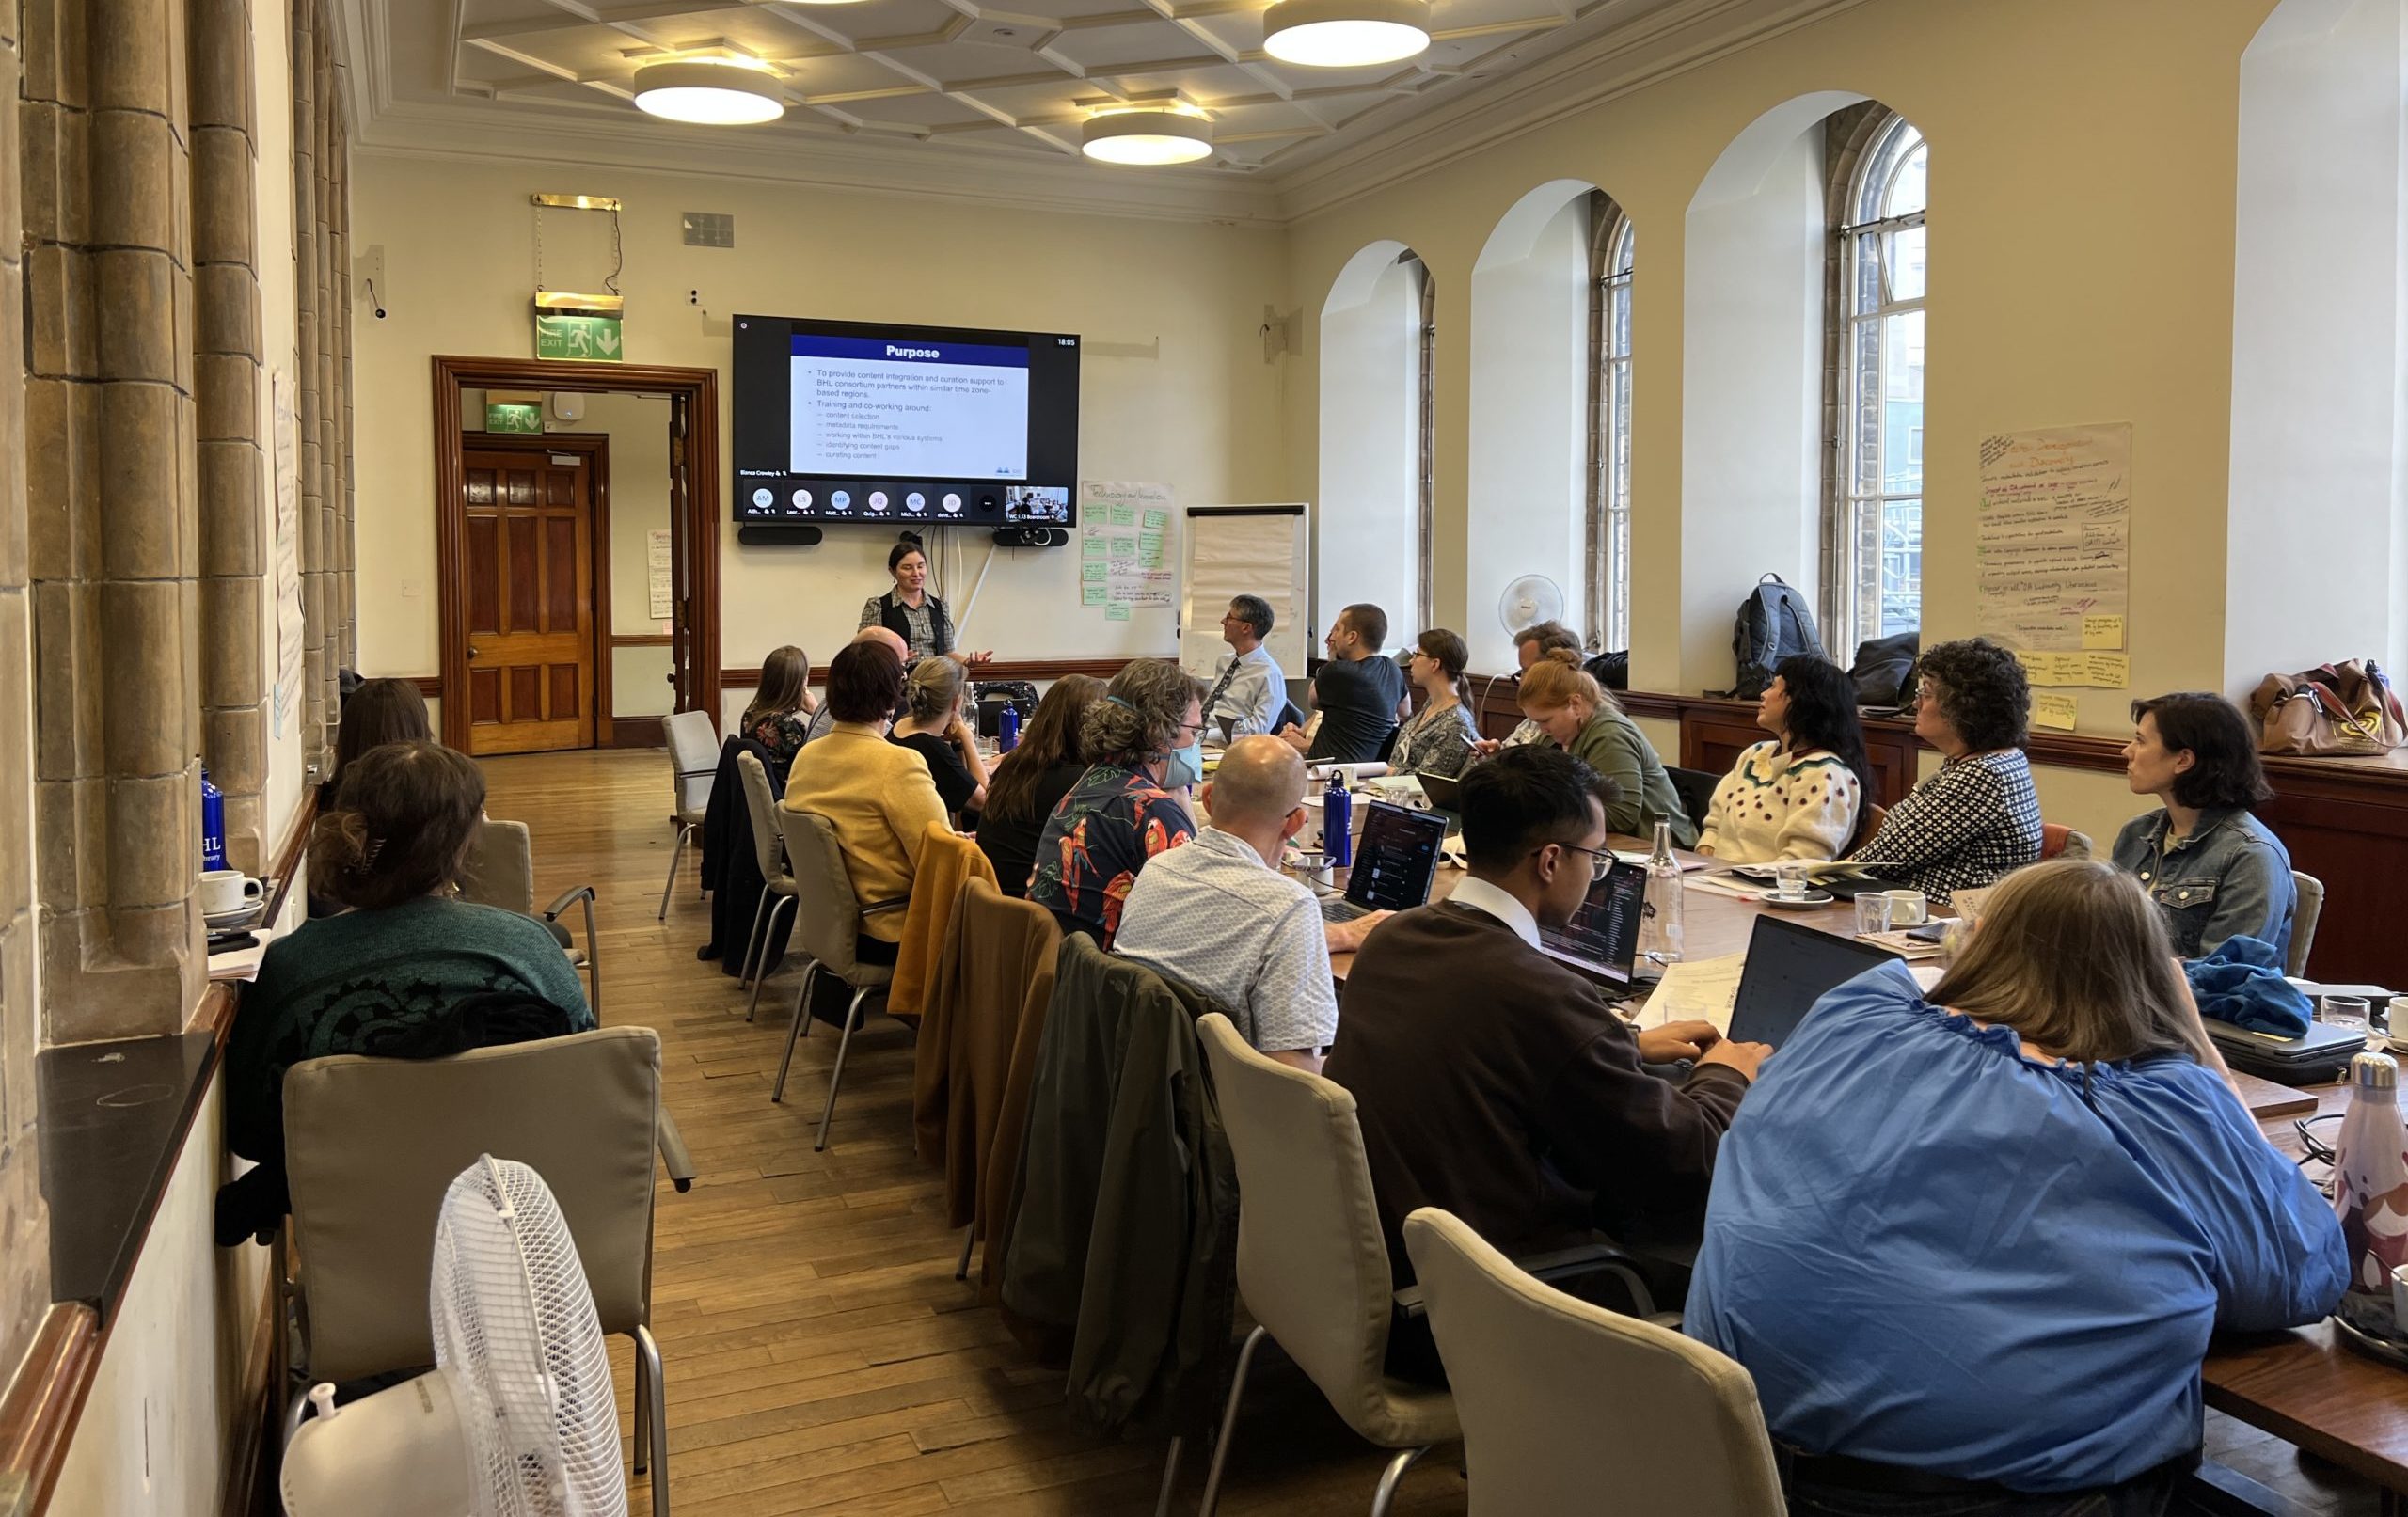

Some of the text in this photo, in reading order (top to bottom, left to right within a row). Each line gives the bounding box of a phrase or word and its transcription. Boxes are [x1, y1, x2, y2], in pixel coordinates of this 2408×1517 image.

[541, 339, 563, 347] EXIT
[1057, 338, 1075, 346] 18:05
[886, 344, 940, 359] Purpose
[816, 369, 827, 377] To
[829, 370, 856, 379] provide
[885, 372, 923, 383] integration
[925, 374, 939, 383] and
[970, 377, 996, 387] support
[834, 380, 875, 388] consortium
[877, 383, 906, 391] partners
[929, 384, 953, 392] similar
[841, 390, 869, 399] regions.
[816, 400, 931, 412] Training and co-working around:
[857, 422, 899, 431] requirements
[826, 432, 851, 440] working
[825, 441, 858, 450] identifying
[825, 451, 852, 460] curating
